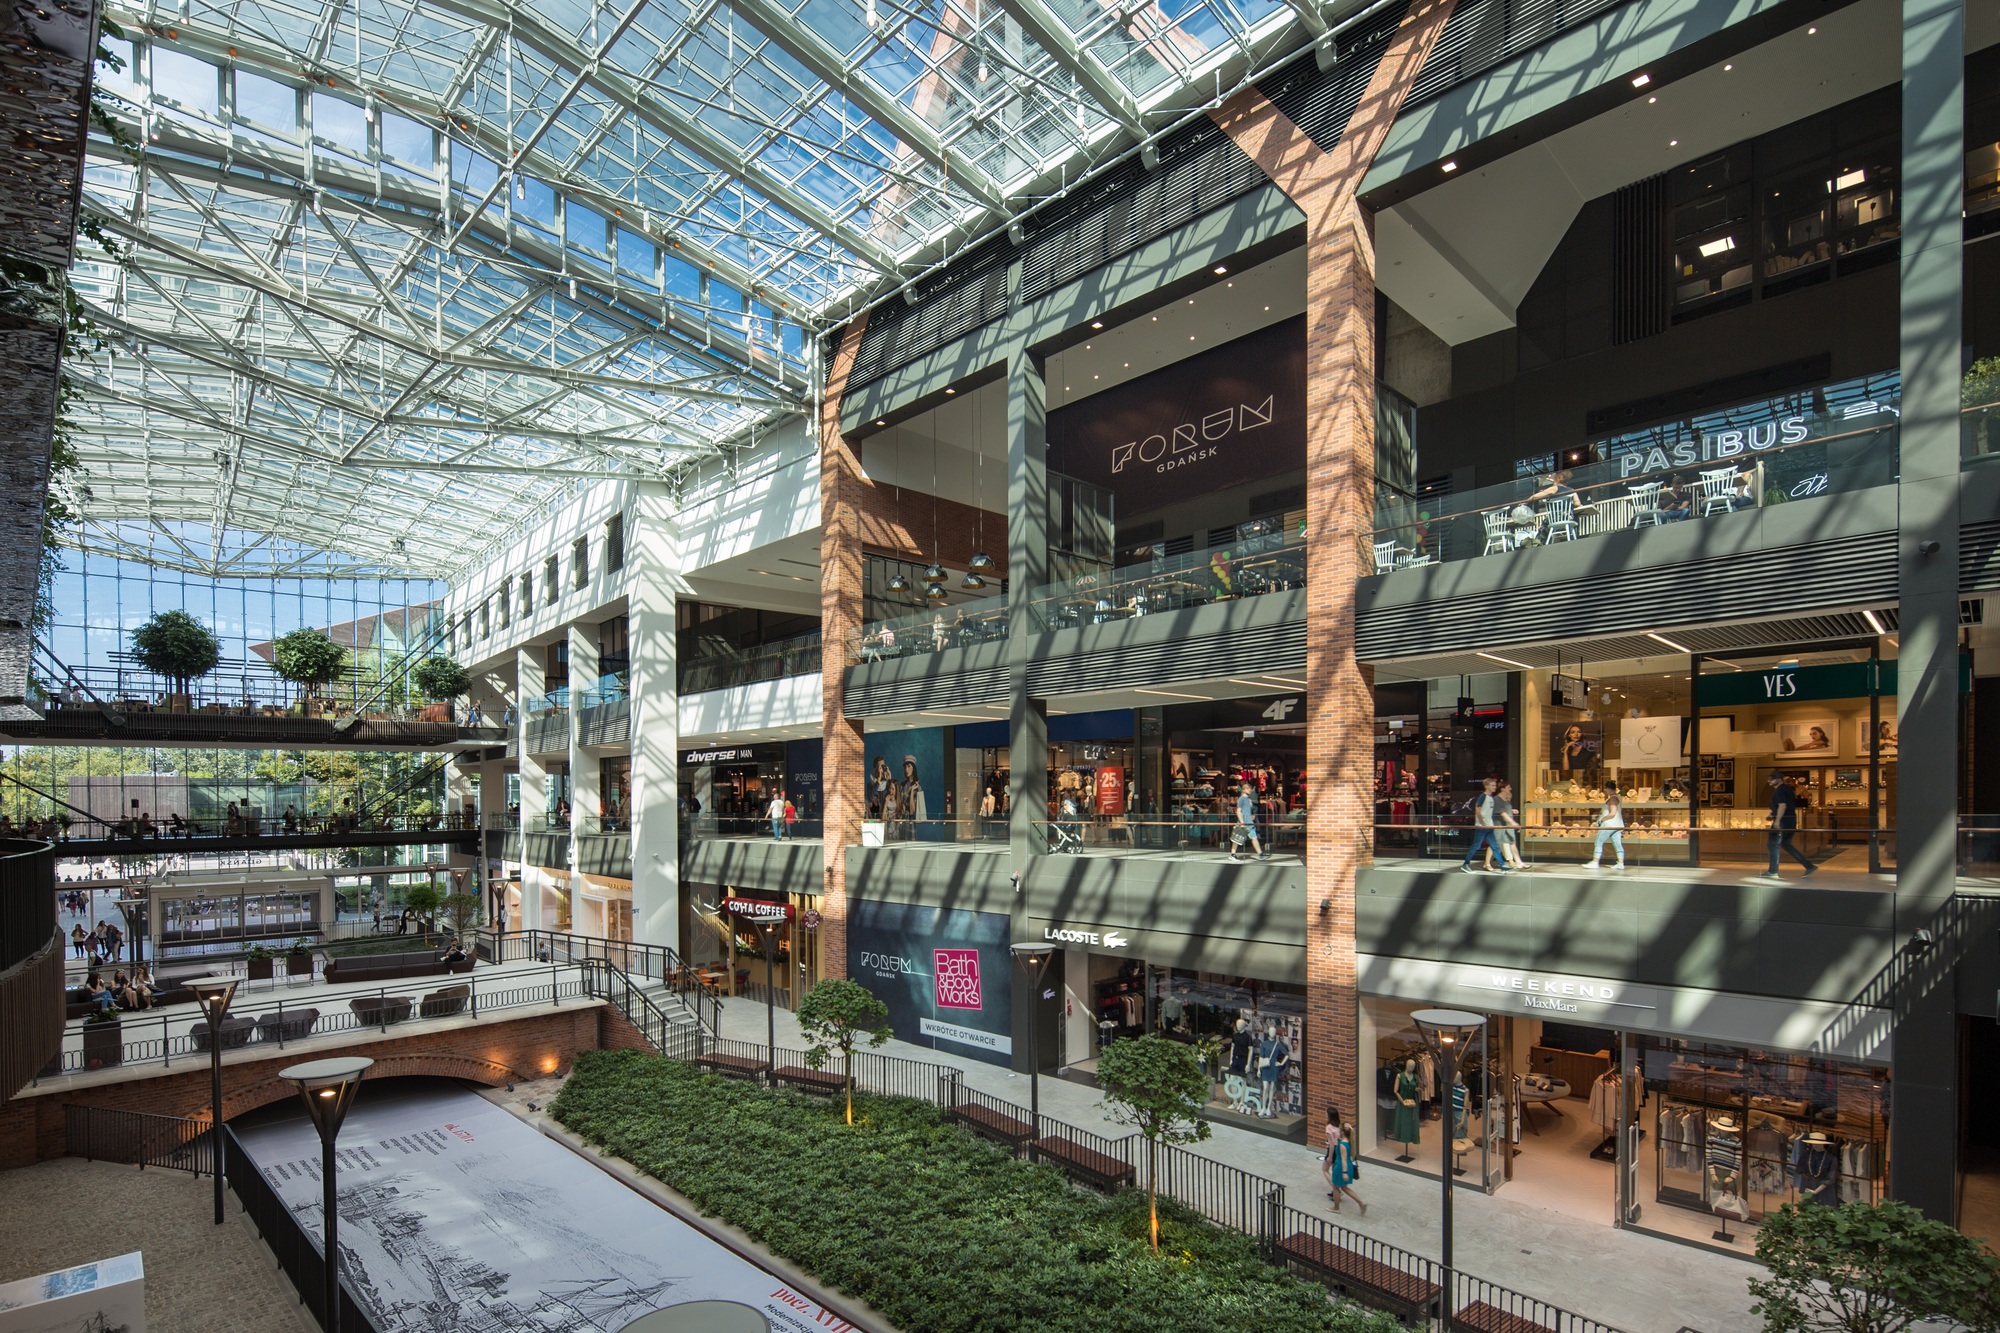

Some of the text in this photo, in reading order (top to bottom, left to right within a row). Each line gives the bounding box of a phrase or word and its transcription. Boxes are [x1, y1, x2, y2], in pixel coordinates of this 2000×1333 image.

[1112, 394, 1273, 473] FORUM
[1621, 415, 1808, 477] PASIBUS
[1157, 446, 1217, 473] GDAŃSK
[1763, 673, 1796, 698] YES
[1262, 699, 1298, 720] 4F
[1464, 707, 1473, 717] 4F
[686, 749, 753, 763] diverse MAN
[1100, 772, 1121, 788] -25%
[728, 900, 787, 917] COSTA COFFEE
[1044, 928, 1099, 945] LACOSTE
[861, 952, 911, 973] FORUM
[936, 953, 978, 977] Bath
[876, 971, 896, 979] GDAŃSK
[938, 974, 978, 991] &Body
[938, 987, 980, 1004] Works
[1491, 975, 1614, 999] WEEKEND
[1524, 996, 1578, 1013] MaxMara
[925, 1023, 996, 1046] WKRÓTCE OTWARCIE
[770, 1287, 810, 1314] pocz.
